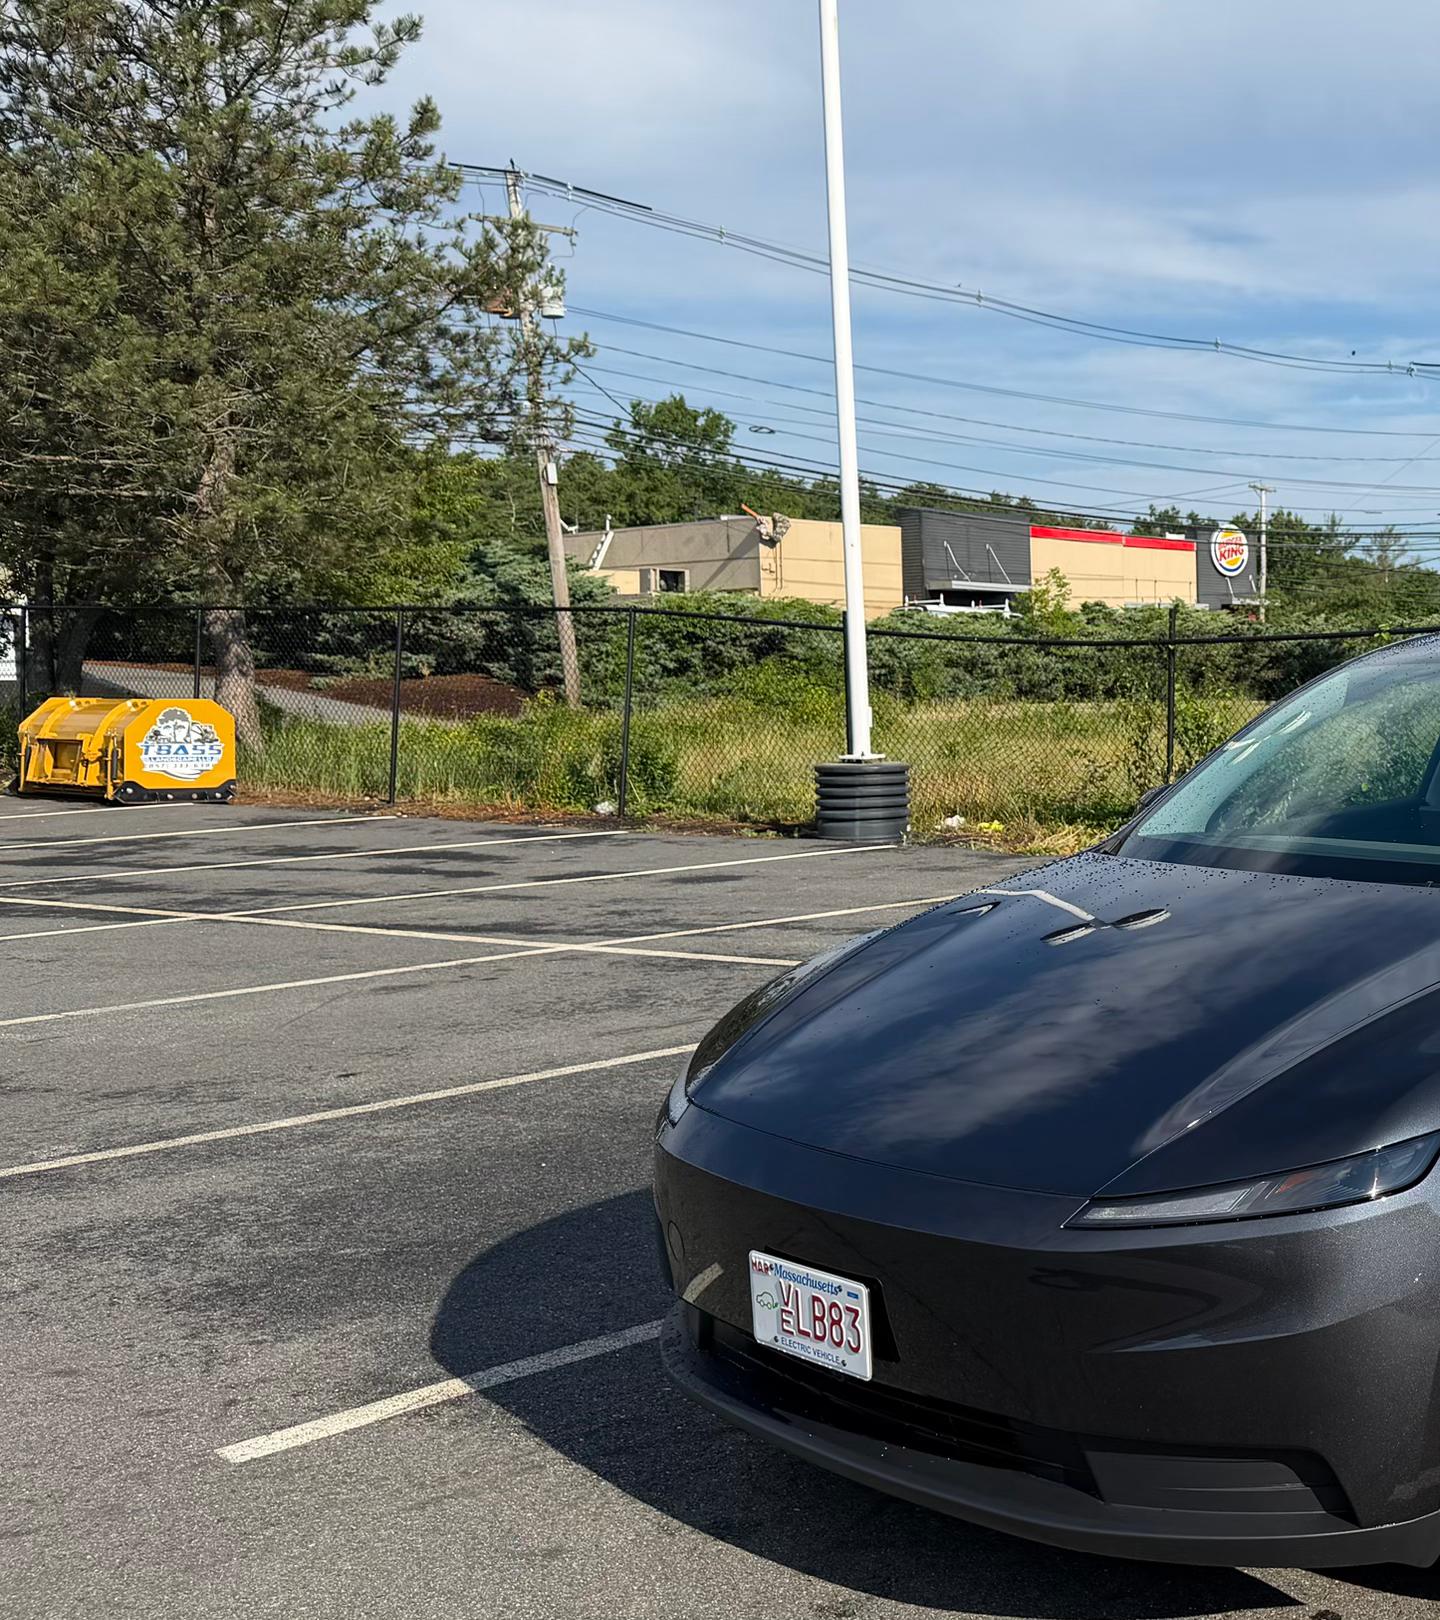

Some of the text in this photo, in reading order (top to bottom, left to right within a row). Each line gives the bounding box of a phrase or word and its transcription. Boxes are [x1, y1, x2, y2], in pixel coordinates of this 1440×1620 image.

[1219, 547, 1244, 561] KING
[774, 1263, 839, 1296] Massachusetts
[781, 1336, 841, 1364] ELECTRIC VEHICLE
